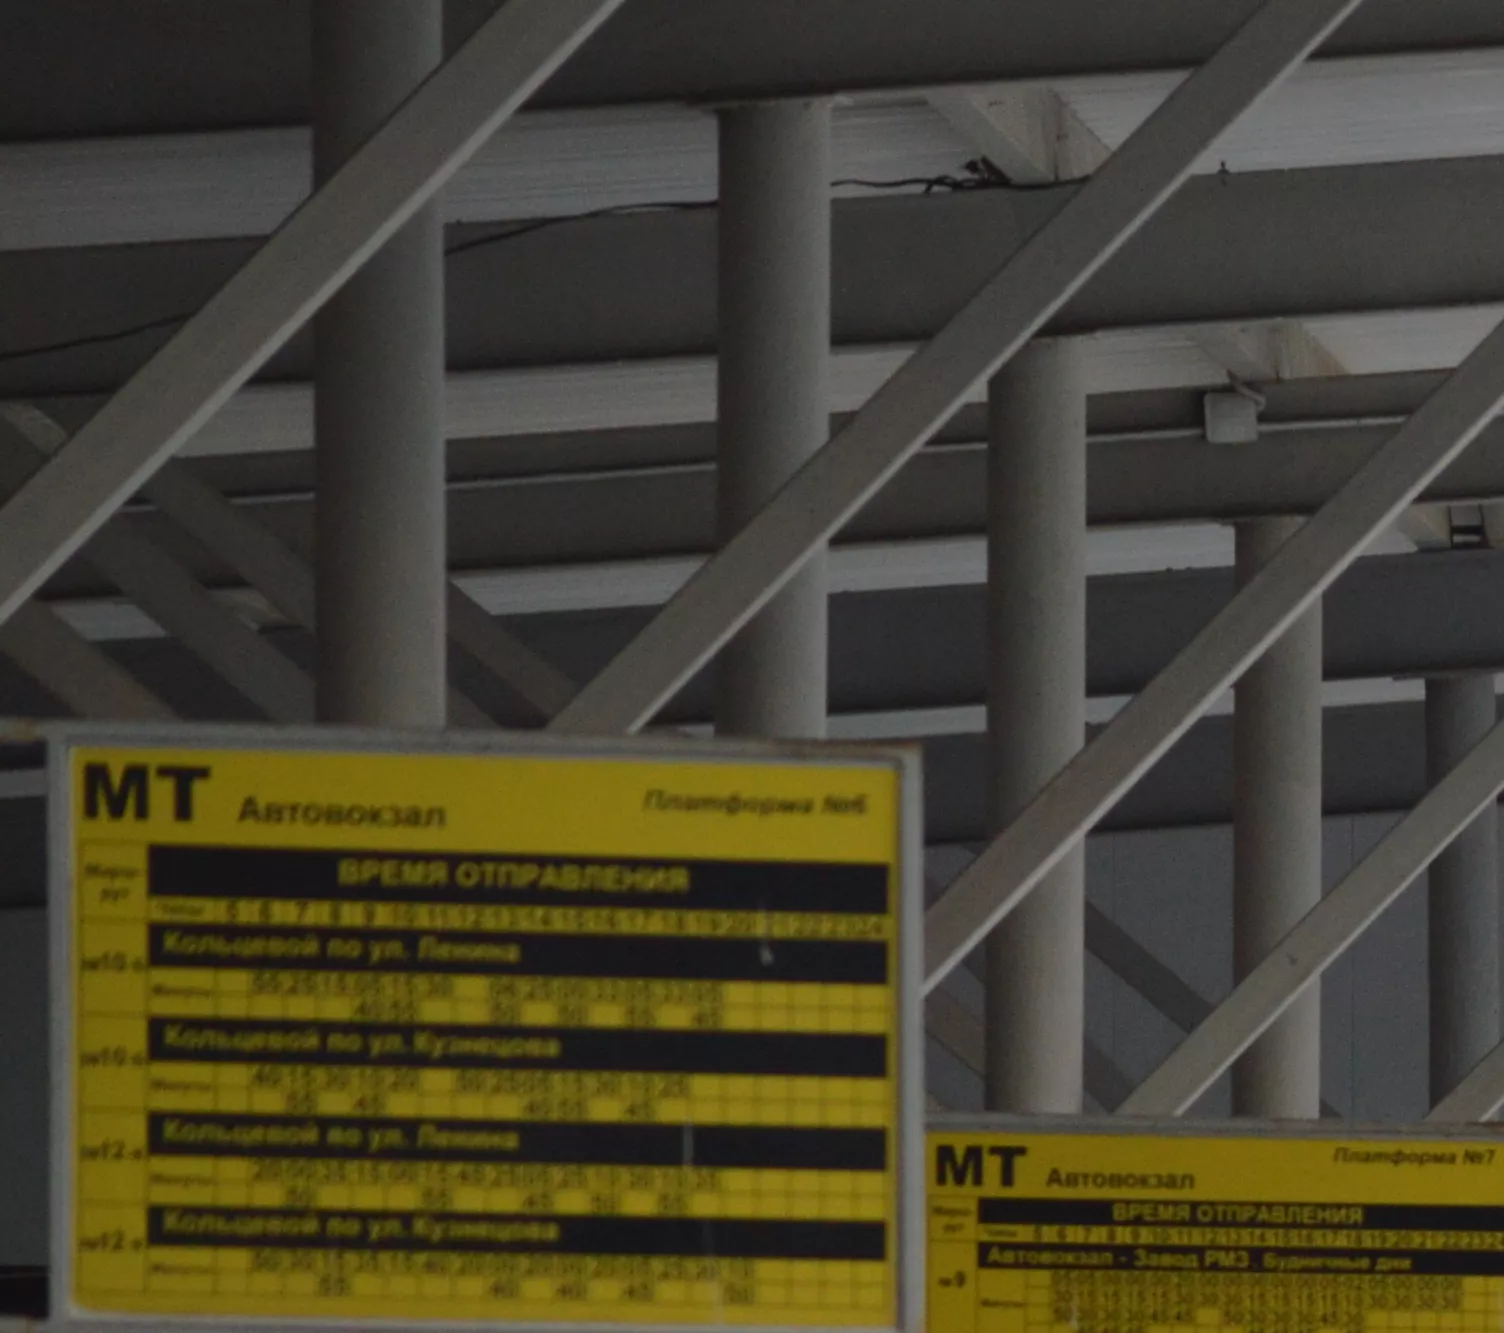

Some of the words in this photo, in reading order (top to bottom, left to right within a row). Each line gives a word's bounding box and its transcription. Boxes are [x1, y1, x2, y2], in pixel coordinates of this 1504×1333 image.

[83, 762, 212, 822] МТ
[237, 795, 447, 829] Автовокзал
[336, 857, 450, 889] ВРЕМЯ
[455, 859, 692, 895] ОТПРАВЛЕНИЯ
[163, 929, 320, 958] Кольцевой
[327, 937, 362, 958] по
[163, 1022, 320, 1051] Кольцевой
[326, 1031, 363, 1051] по
[163, 1116, 320, 1144] Кольцевой
[326, 1125, 363, 1146] по
[935, 1143, 1029, 1188] МТ
[1333, 1146, 1457, 1167] Платформа
[1046, 1166, 1195, 1189] Автовокзал
[163, 1208, 320, 1238] Кольцевой
[326, 1217, 363, 1238] по
[1113, 1202, 1190, 1222] ВРЕМЯ
[1196, 1203, 1363, 1225] ОТПРАВЛЕНИЯ
[986, 1244, 1114, 1267] Автовокзал
[1133, 1247, 1199, 1268] Завод
